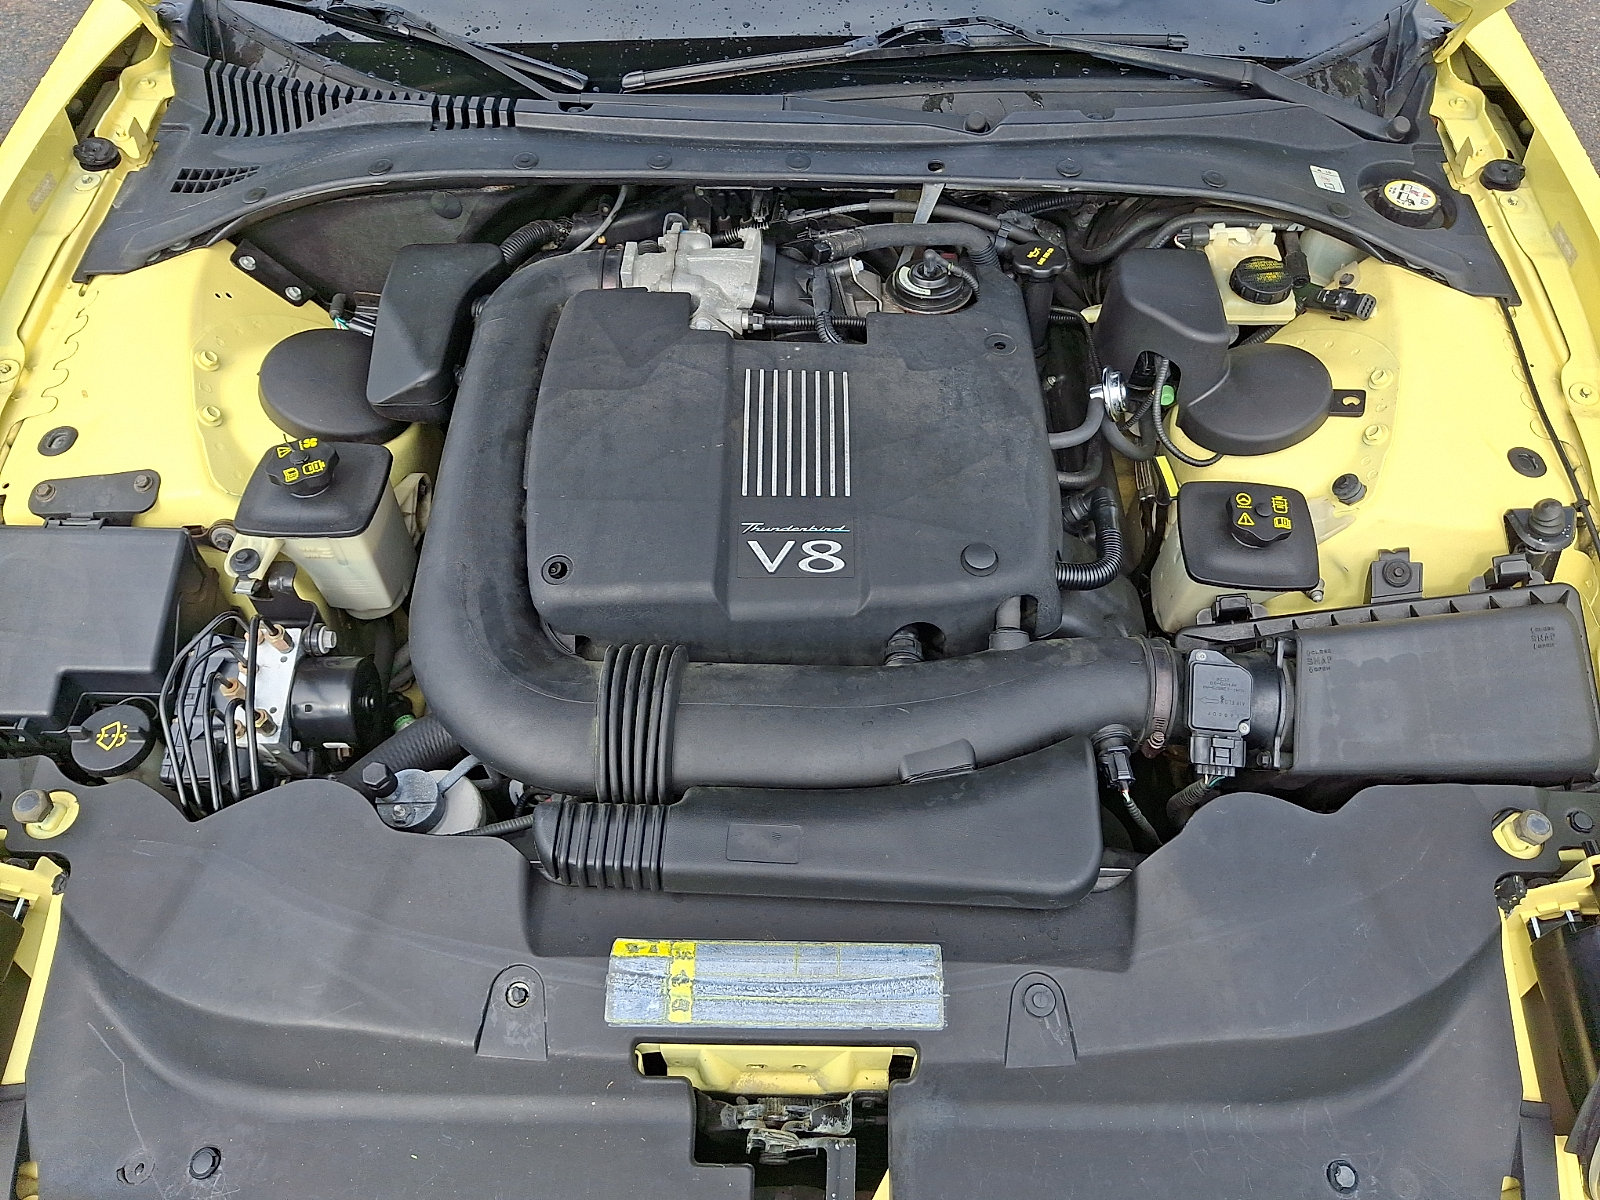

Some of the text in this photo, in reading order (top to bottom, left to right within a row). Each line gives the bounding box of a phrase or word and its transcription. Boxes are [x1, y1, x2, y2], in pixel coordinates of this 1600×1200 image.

[741, 522, 851, 534] Thunderbird
[747, 539, 846, 574] V8
[1306, 656, 1332, 665] SNAP
